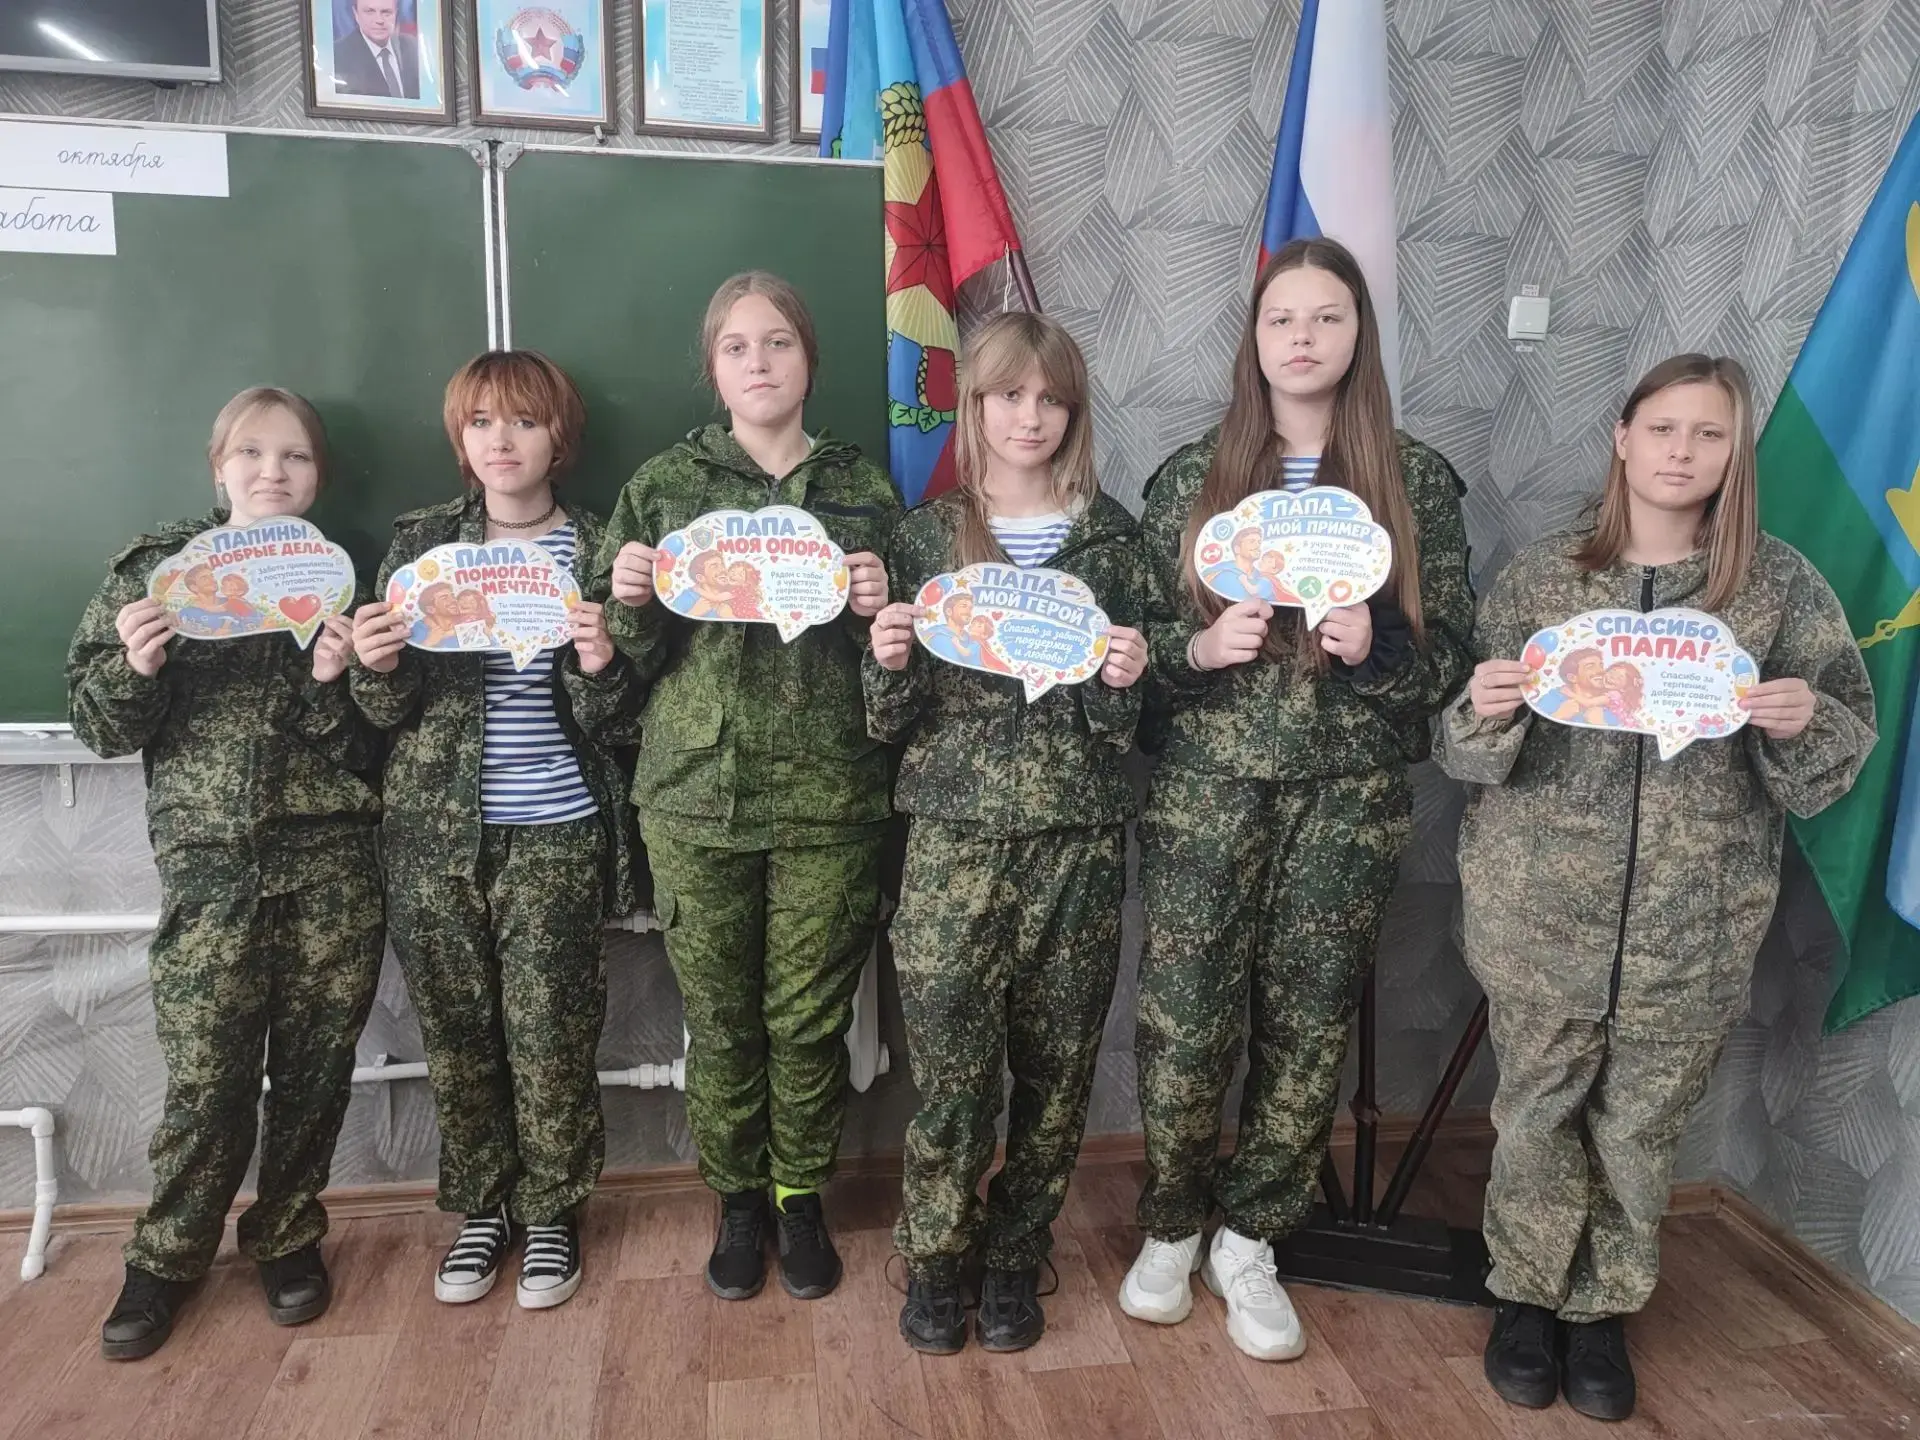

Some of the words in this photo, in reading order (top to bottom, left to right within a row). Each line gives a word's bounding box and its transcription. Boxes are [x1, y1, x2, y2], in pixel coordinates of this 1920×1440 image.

[57, 142, 165, 178] октября
[1272, 497, 1333, 518] ПАПА
[726, 516, 797, 537] ПАПА
[1267, 518, 1302, 537] МОЙ
[1306, 519, 1372, 539] ПРИМЕР
[212, 524, 307, 553] ПАПИНЫ
[716, 537, 762, 554] МОЯ
[765, 537, 833, 560] ОПОРА
[207, 543, 277, 570] ДОБРЫЕ
[281, 541, 325, 556] ДЕЛА
[455, 547, 527, 568] ПАПА
[455, 565, 553, 585] ПОМОГАЕТ
[771, 571, 795, 579] Рядом
[802, 572, 824, 580] тобой
[783, 580, 820, 588] чувствую
[982, 567, 1057, 596] ПАПА
[481, 580, 561, 598] МЕЧТАТЬ
[977, 587, 1021, 606] МОЙ
[1026, 596, 1086, 626] ГЕРОЙ
[1003, 621, 1040, 634] Спасибо
[1041, 629, 1053, 638] за
[1015, 636, 1073, 655] поддержку
[1611, 635, 1711, 663] ПАПА!
[1024, 650, 1069, 665] любовь!
[1660, 671, 1702, 681] Спасибо
[1703, 676, 1715, 684] за
[1651, 688, 1687, 698] добрые
[1688, 692, 1722, 702] советы
[1662, 699, 1684, 708] веру
